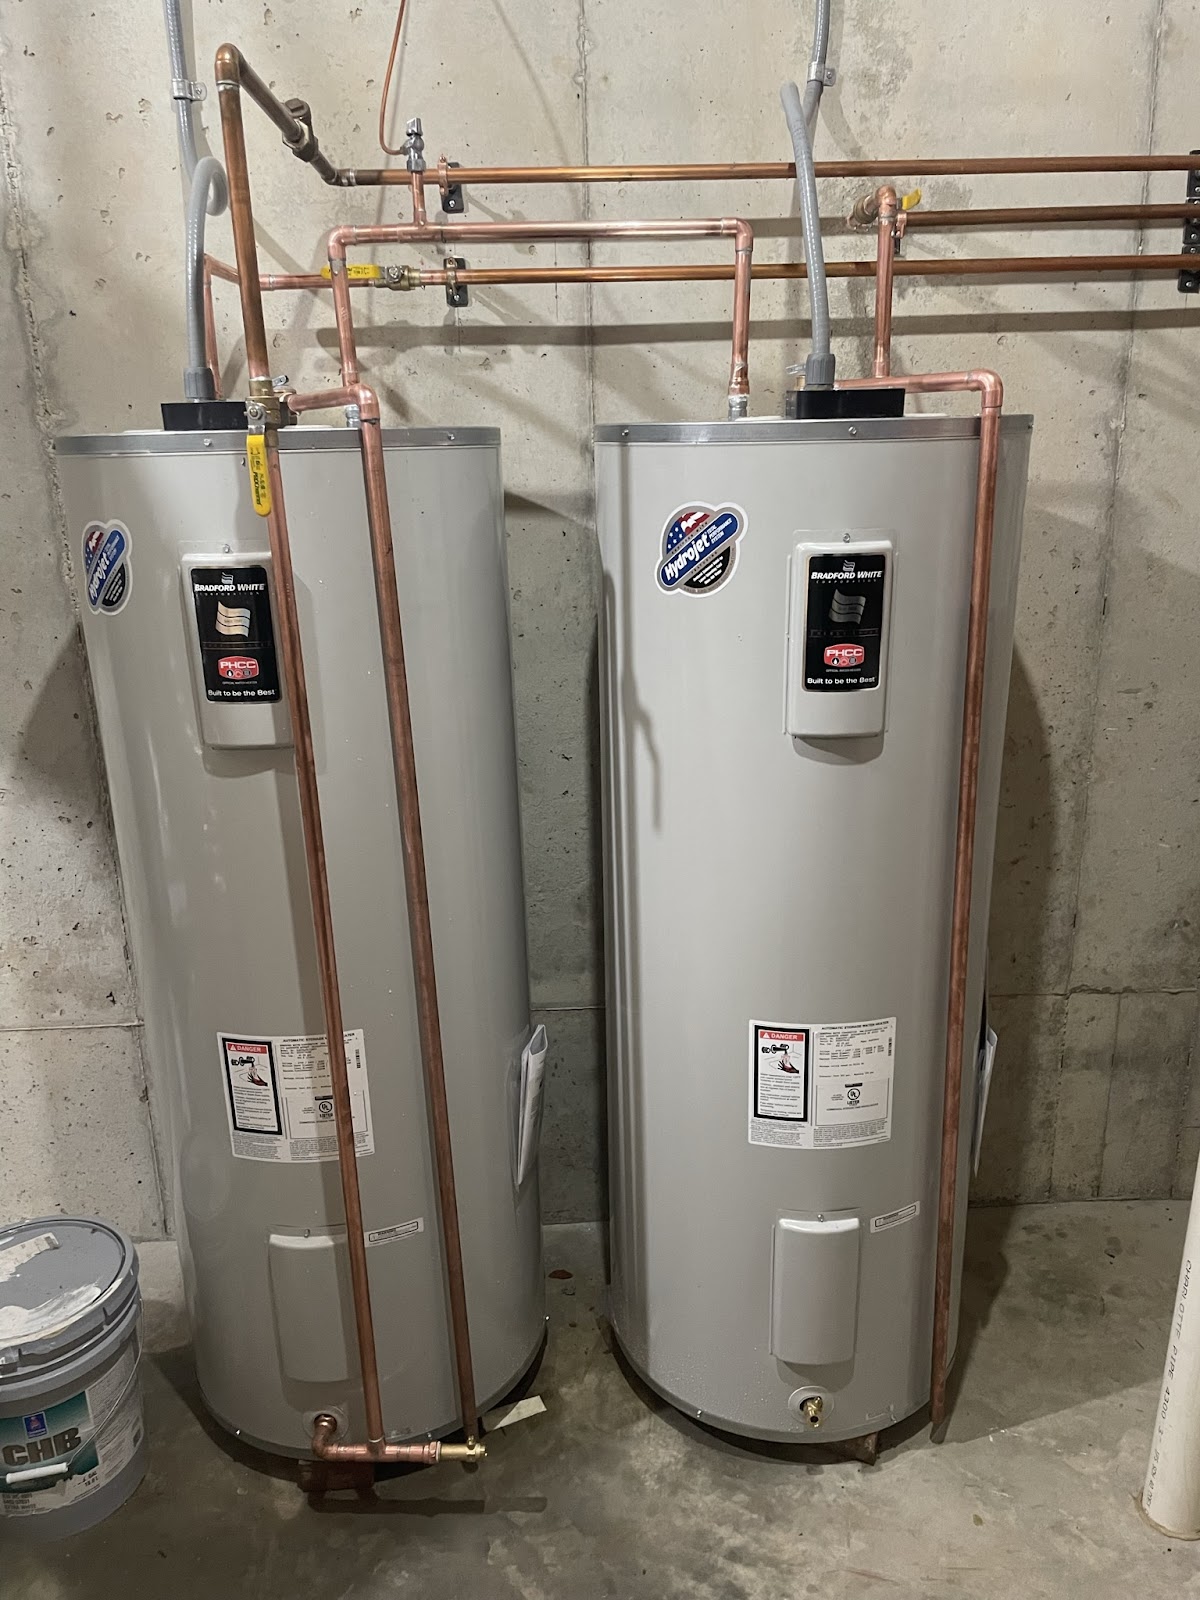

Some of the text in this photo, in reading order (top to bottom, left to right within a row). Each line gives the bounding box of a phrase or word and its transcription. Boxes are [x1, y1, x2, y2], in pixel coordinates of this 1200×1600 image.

[664, 532, 711, 581] Hydrojet
[811, 572, 856, 580] BRADFORD
[826, 648, 863, 656] PHCC
[1168, 1344, 1178, 1380] PIPE
[1161, 1386, 1170, 1420] 4300
[2, 1428, 81, 1466] CHB
